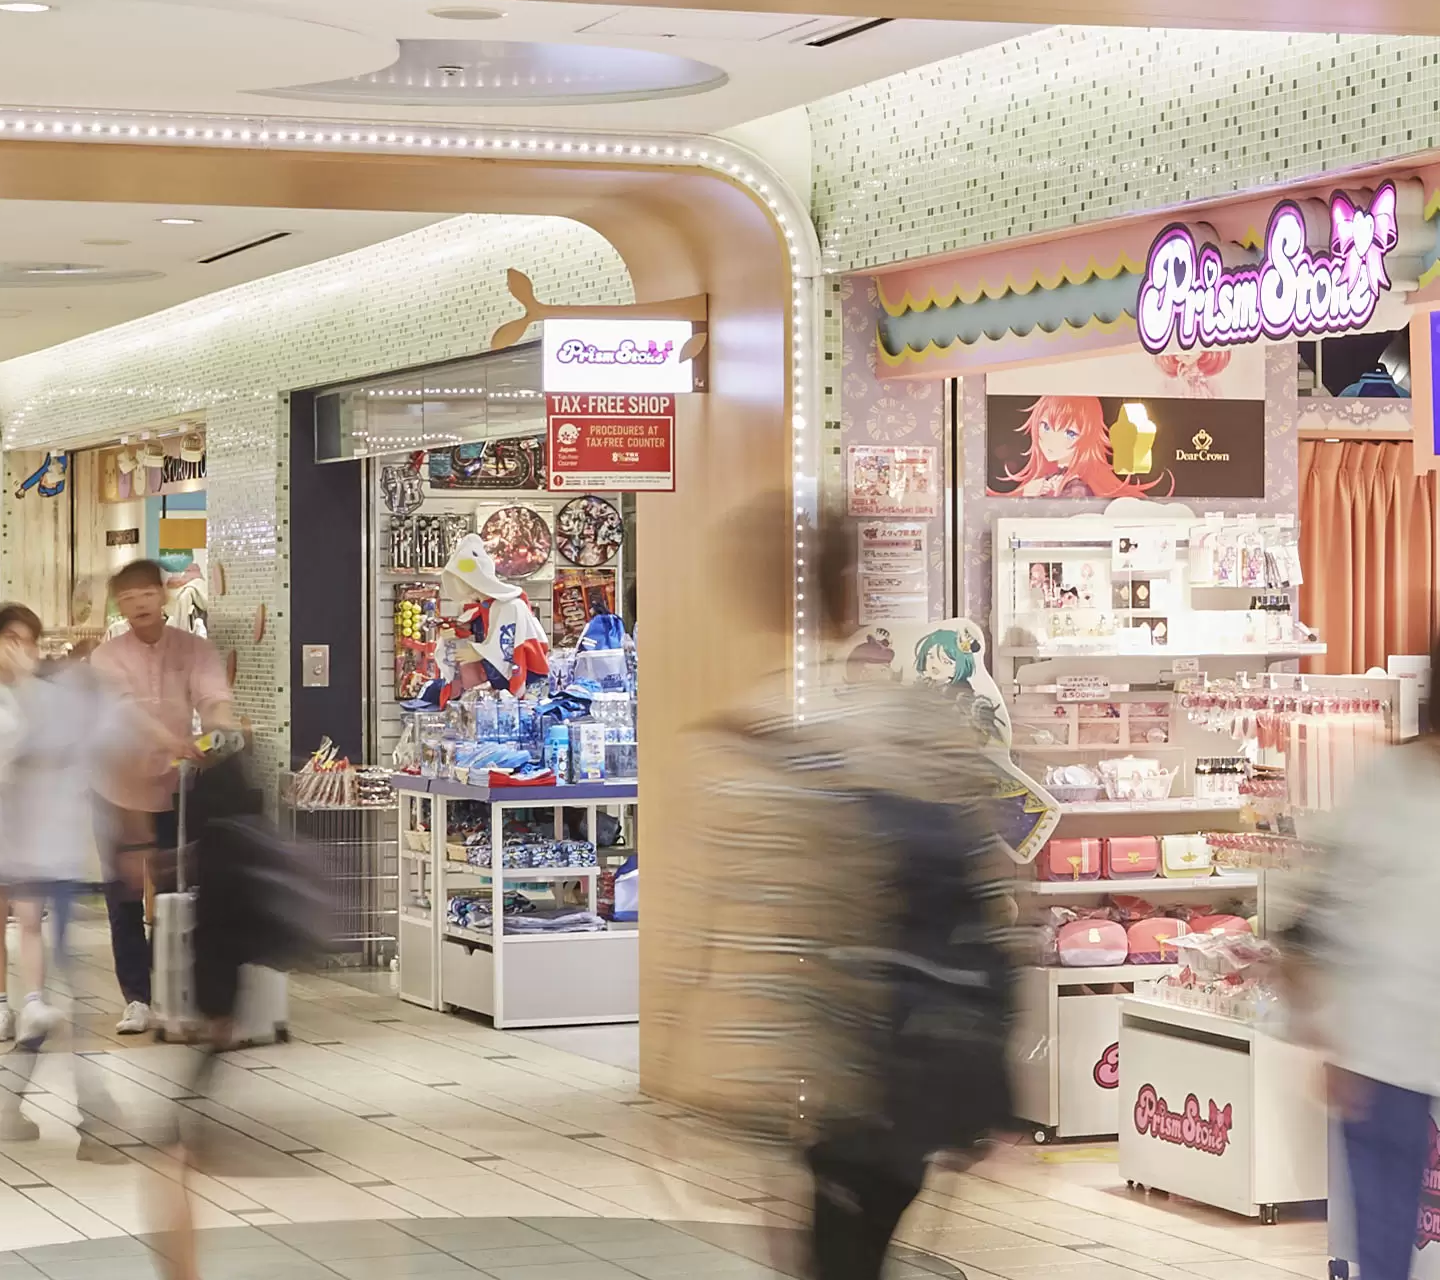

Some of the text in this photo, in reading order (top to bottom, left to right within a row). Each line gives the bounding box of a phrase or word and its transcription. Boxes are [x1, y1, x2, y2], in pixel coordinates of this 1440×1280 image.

[1140, 209, 1374, 344] Prism Stone
[557, 339, 616, 364] Prism
[552, 396, 670, 414] TAX-FREE SHOP
[590, 425, 659, 436] PROCEDURES AT
[585, 437, 666, 449] TAX-FREE COUNTER
[1136, 1087, 1226, 1152] Prism Stone
